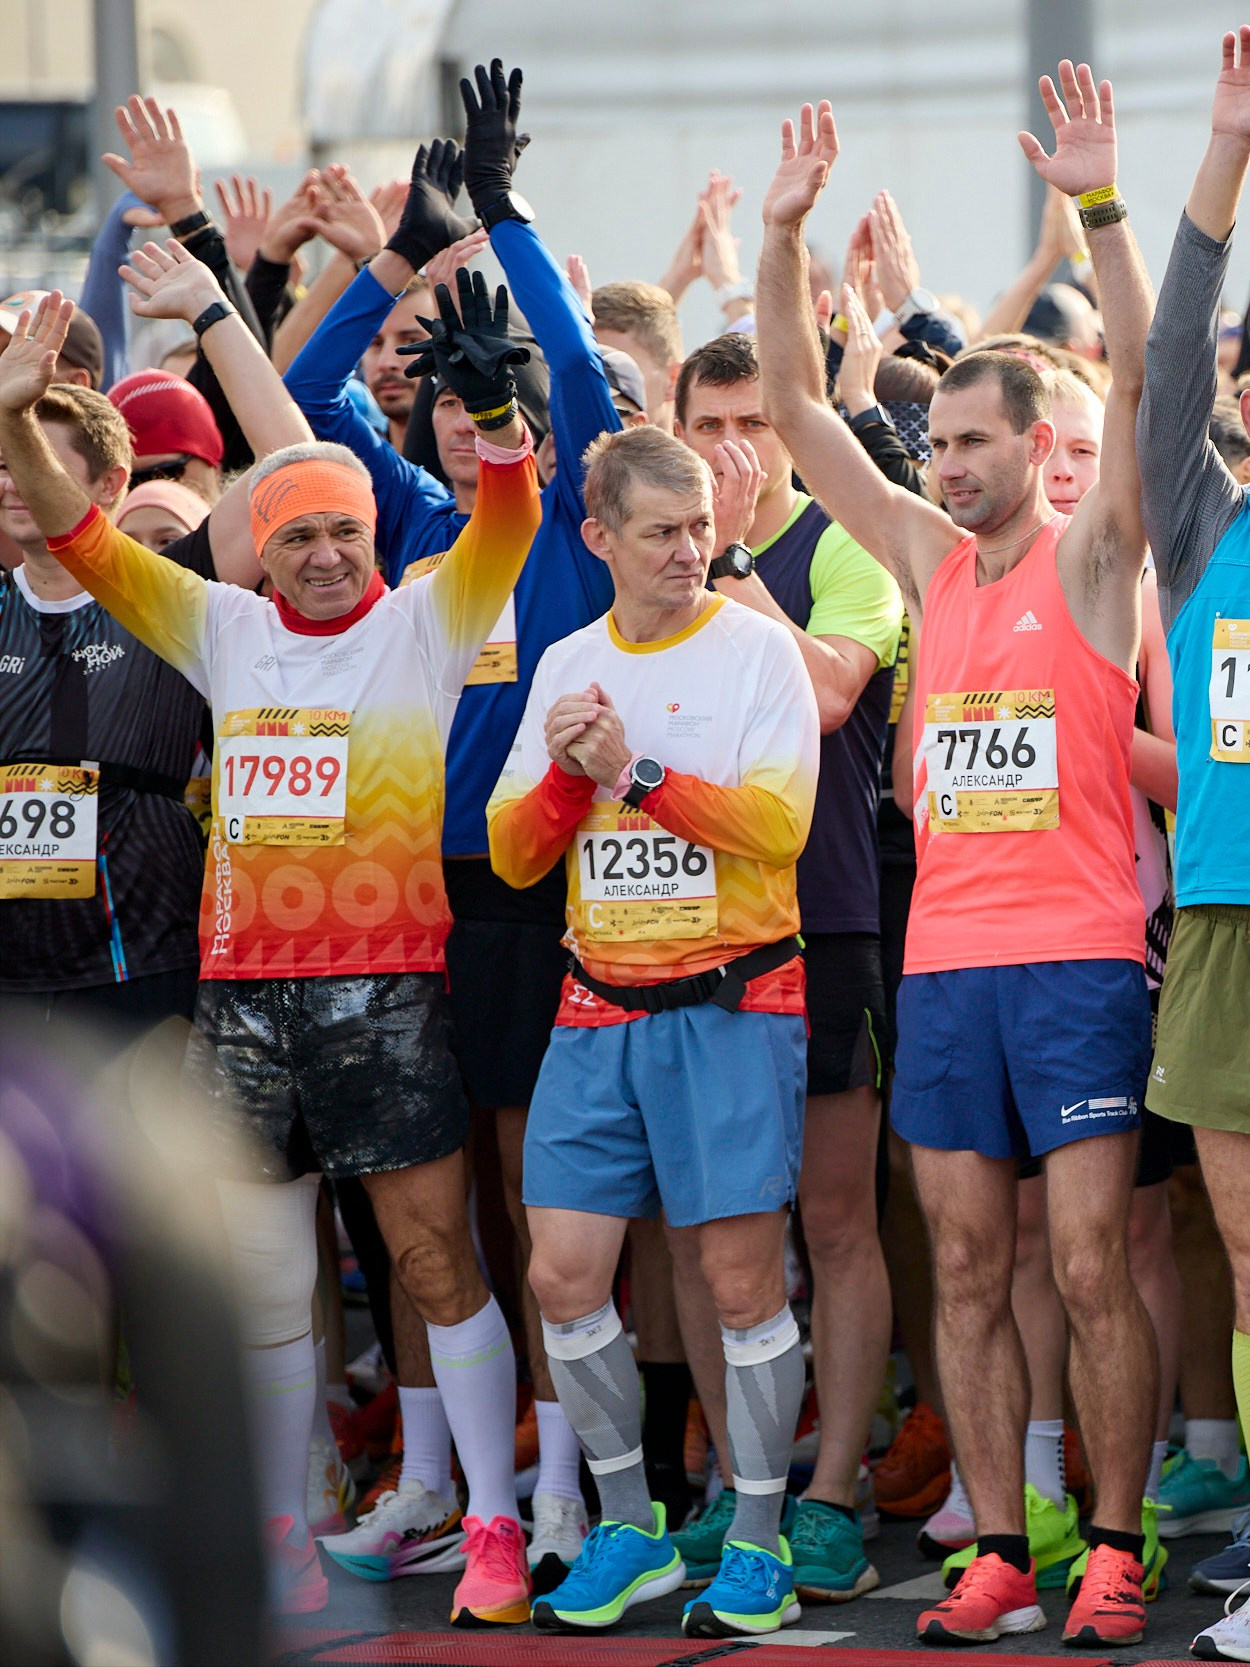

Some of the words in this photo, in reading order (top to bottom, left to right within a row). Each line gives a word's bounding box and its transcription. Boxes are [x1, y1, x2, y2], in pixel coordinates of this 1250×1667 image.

[1013, 623, 1042, 632] adidas
[937, 727, 1036, 770] 7766
[225, 755, 341, 797] 17989
[952, 774, 1023, 788] АЛЕКСАНДР
[0, 799, 76, 839] 698
[584, 837, 708, 880] 12356
[218, 844, 232, 954] МОСКВА
[604, 883, 679, 897] АЛЕКСАНДР
[1089, 1111, 1107, 1119] Sports
